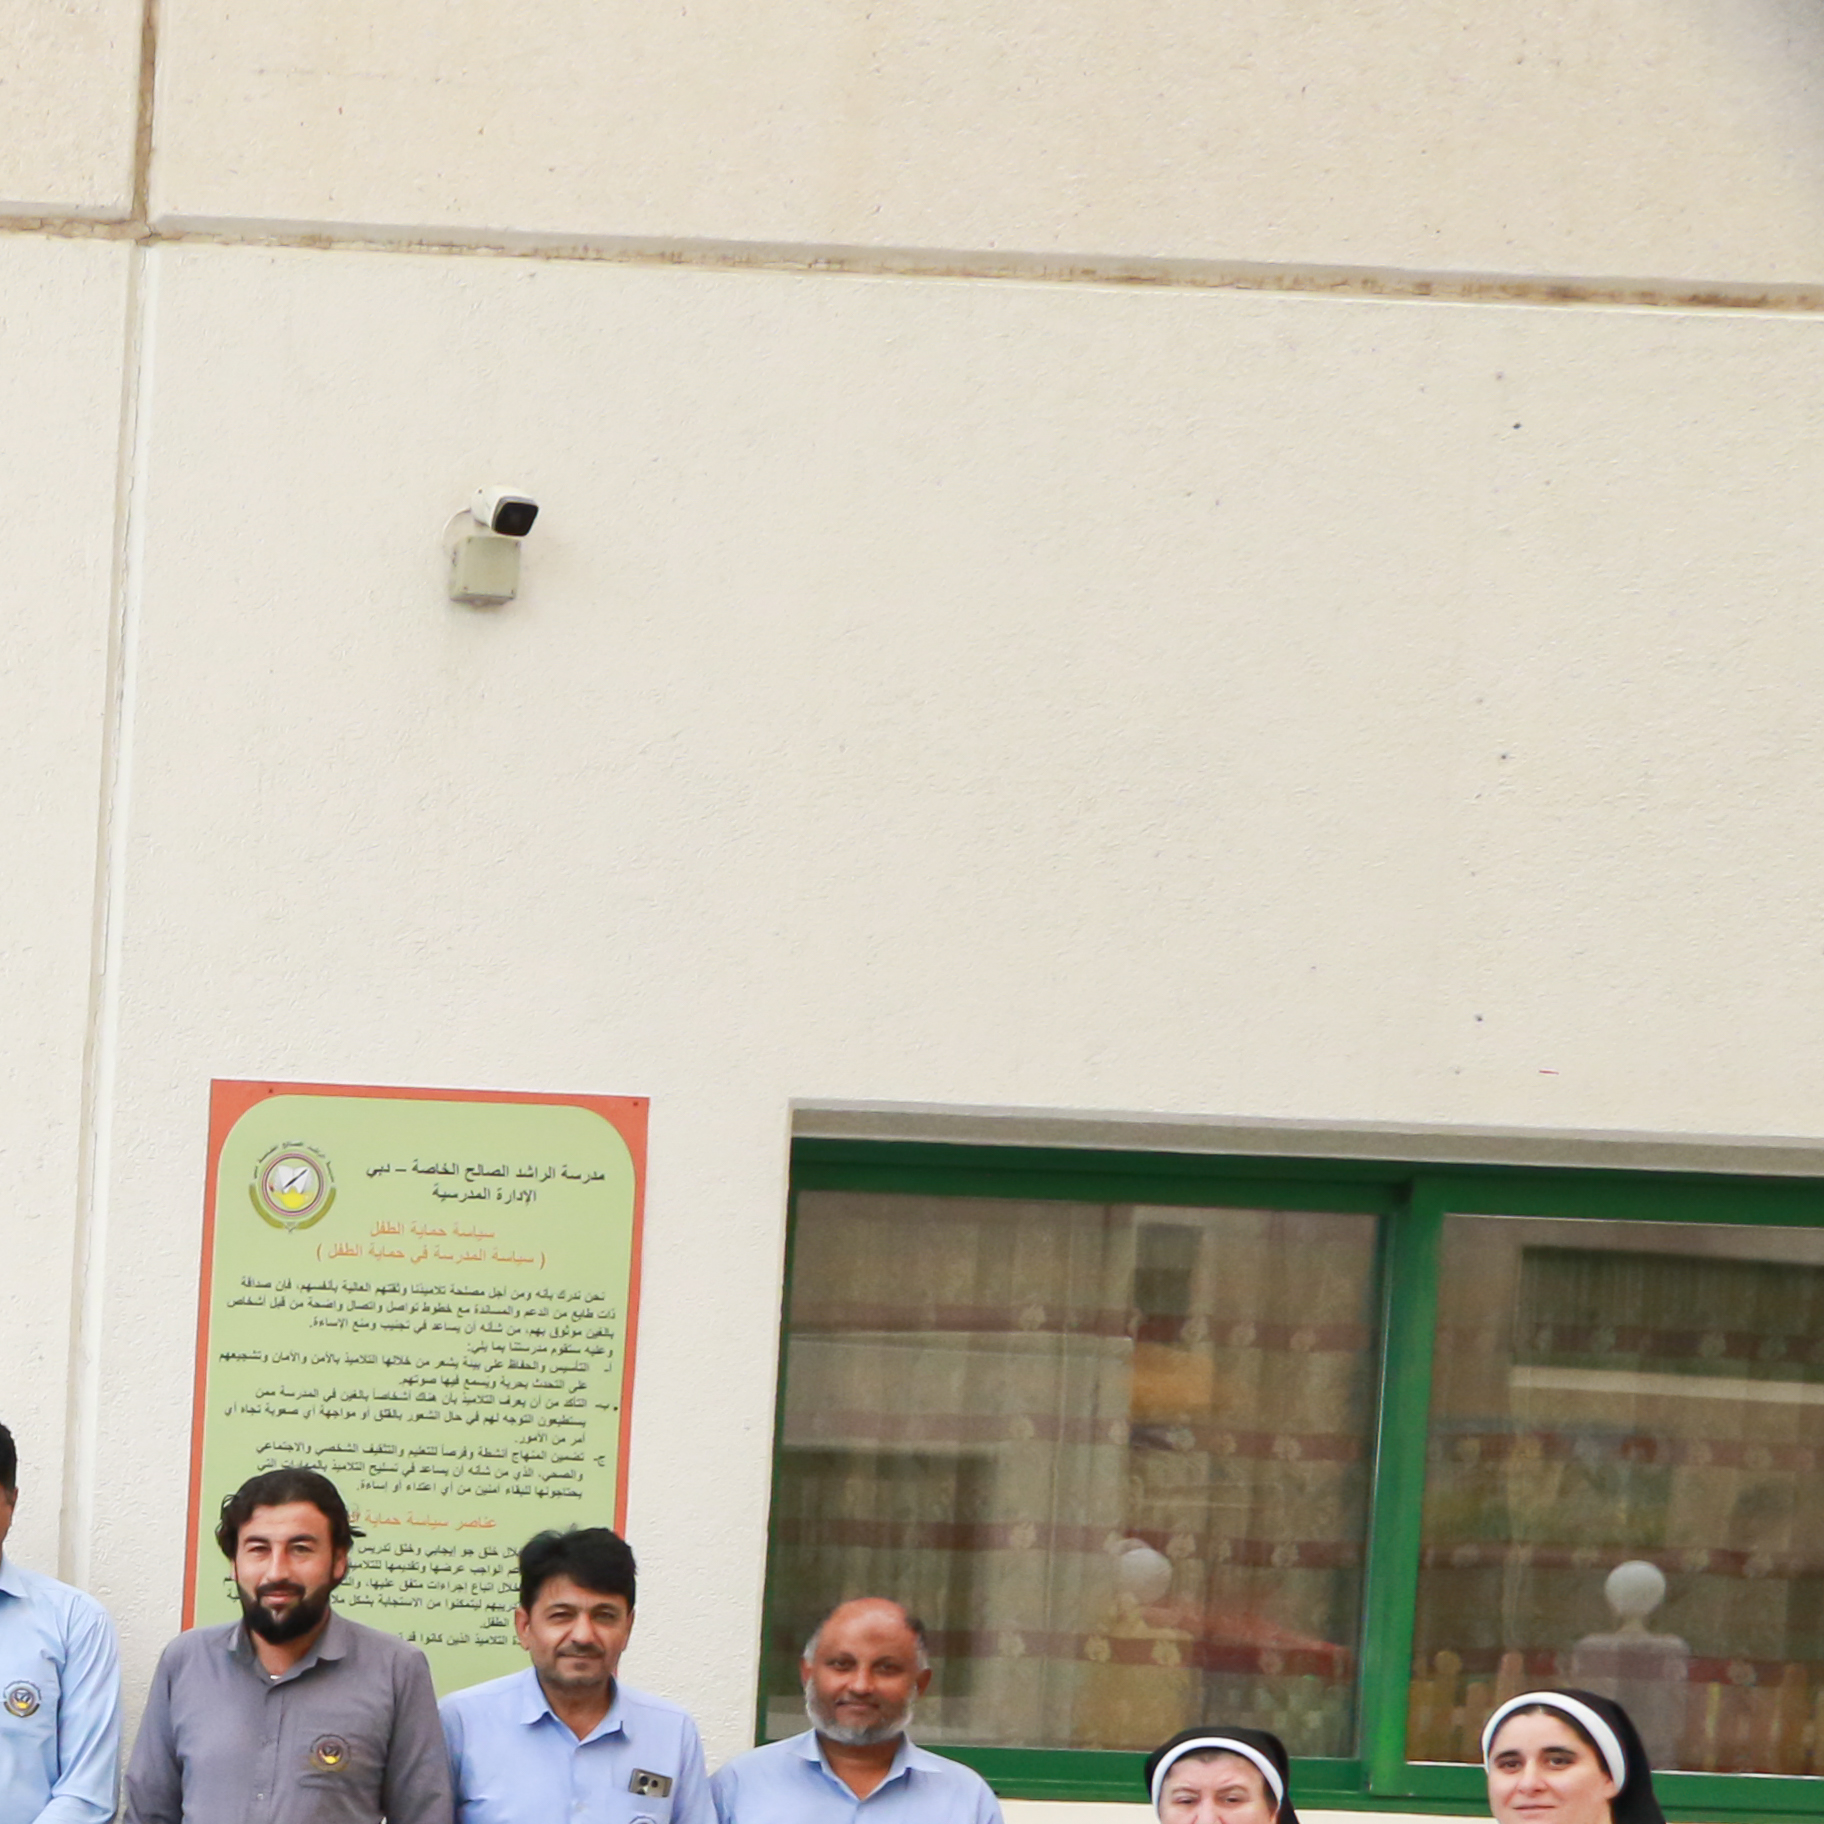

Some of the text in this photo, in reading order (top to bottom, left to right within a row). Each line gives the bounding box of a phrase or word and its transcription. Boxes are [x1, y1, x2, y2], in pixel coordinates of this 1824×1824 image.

[366, 1160, 605, 1182] مدرسة الراشد الصالح الخاصة دبي
[432, 1188, 491, 1203] المدرسية
[371, 1220, 496, 1239] سياسة حماية الطفل
[329, 1242, 534, 1263] سياسة المدرسة في حماية الطفل
[364, 1509, 401, 1528] حماية
[406, 1511, 449, 1530] سياسة
[455, 1515, 496, 1531] عناصر
